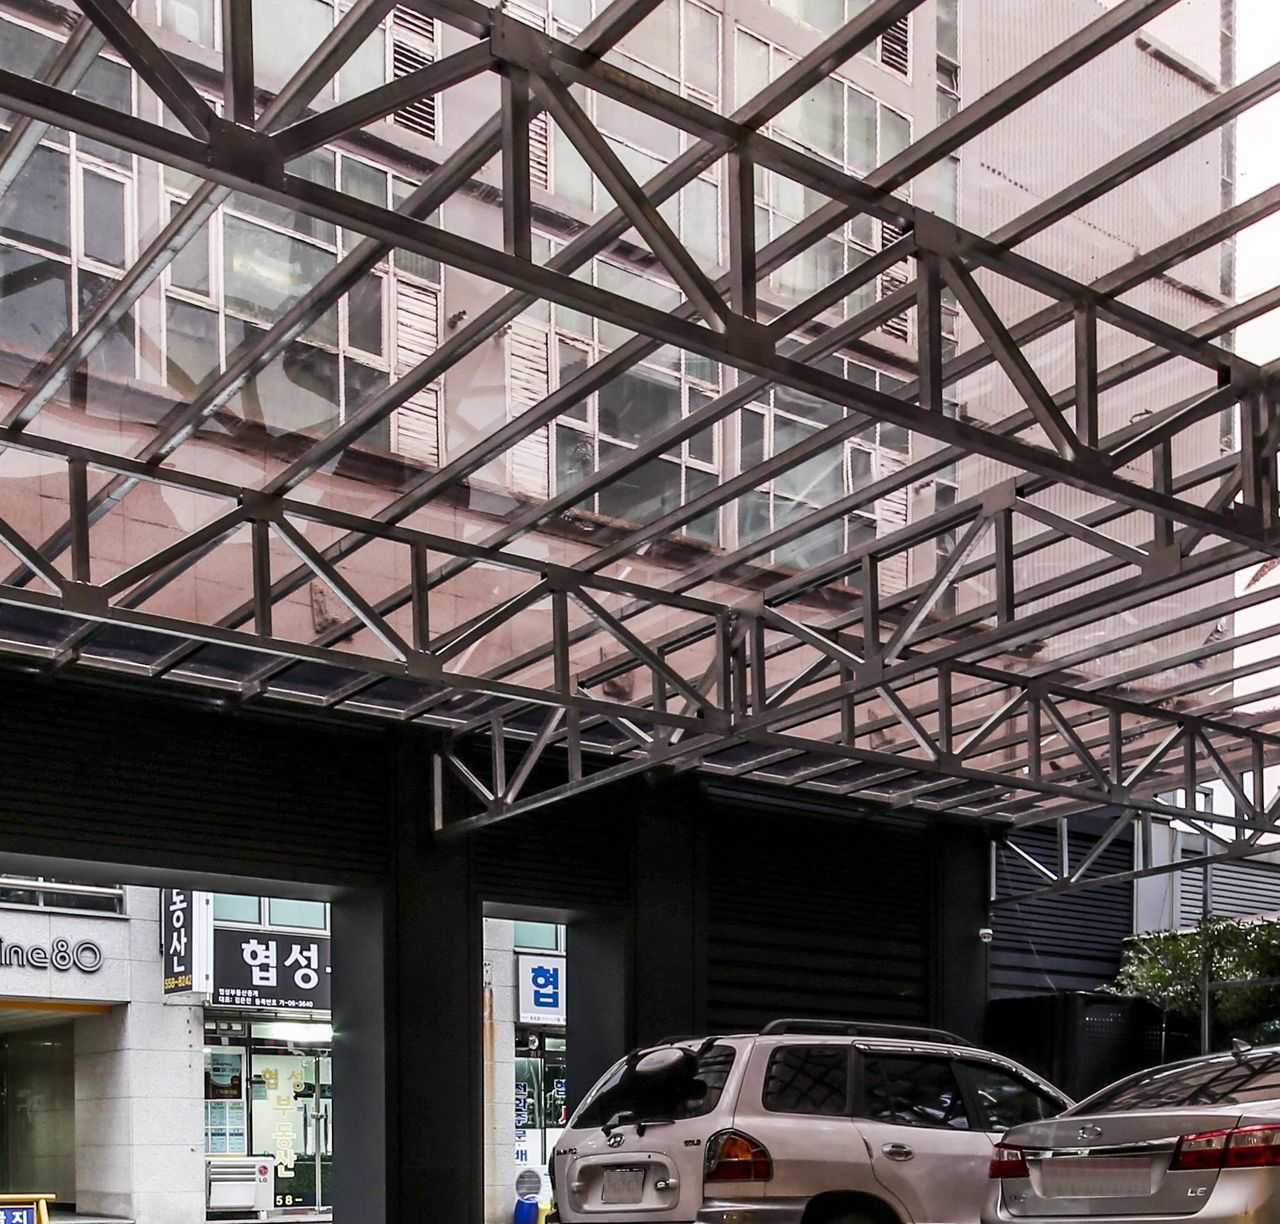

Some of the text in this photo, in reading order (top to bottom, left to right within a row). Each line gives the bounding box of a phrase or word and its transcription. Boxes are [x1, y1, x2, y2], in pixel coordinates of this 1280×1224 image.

[531, 965, 560, 1008] 협
[273, 1095, 298, 1178] 부동산
[1187, 1187, 1207, 1196] LE
